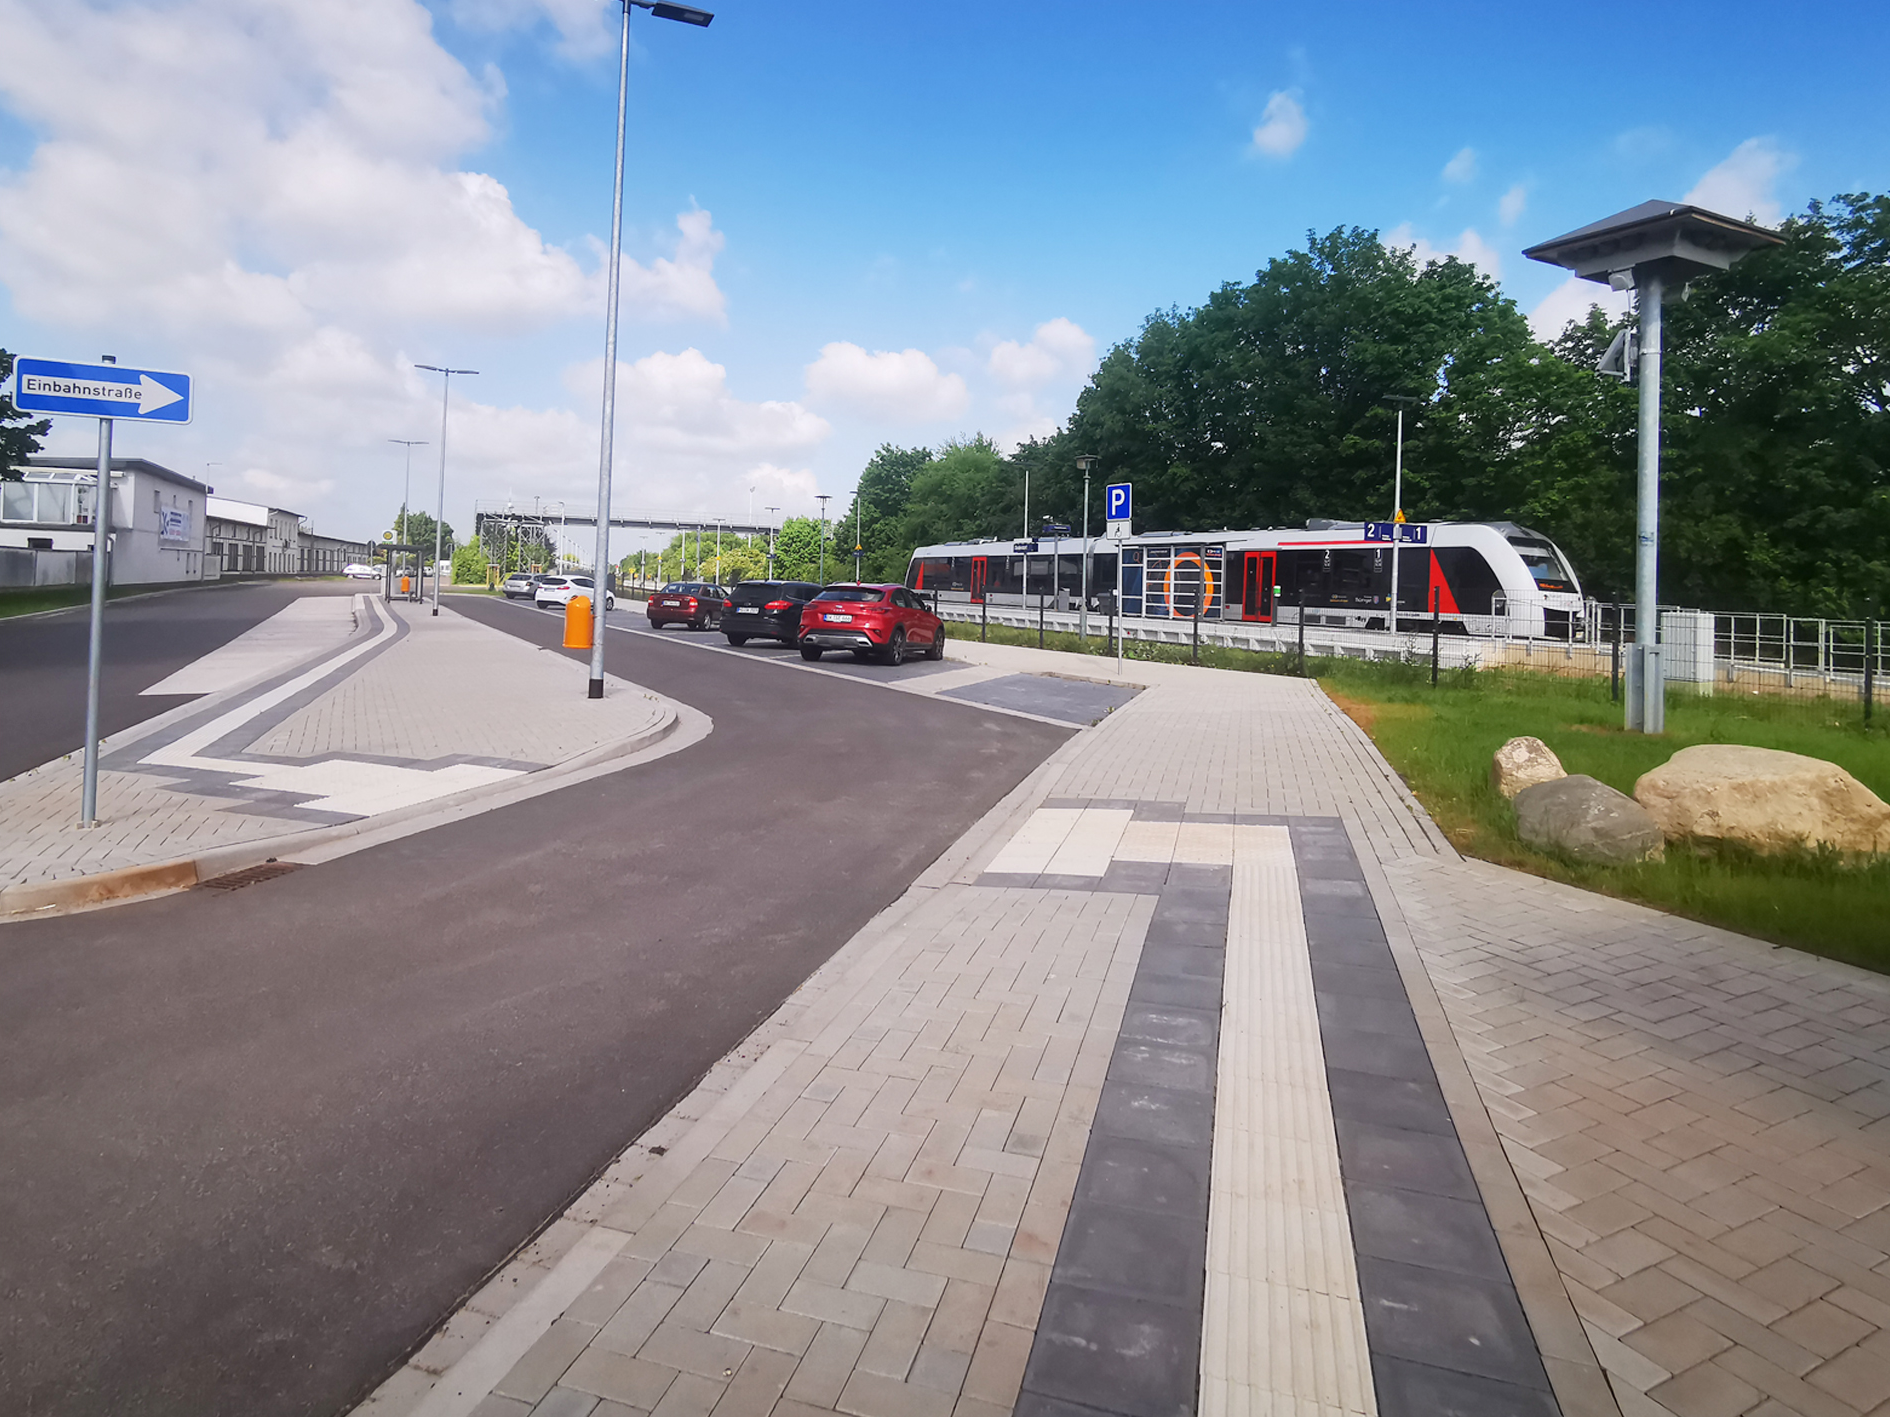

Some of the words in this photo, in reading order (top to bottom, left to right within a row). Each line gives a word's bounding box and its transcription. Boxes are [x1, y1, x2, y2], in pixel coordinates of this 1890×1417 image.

[27, 378, 142, 400] Einbahnstraße
[1112, 488, 1126, 516] P
[1367, 523, 1376, 538] 2
[1415, 526, 1422, 541] 1
[1324, 549, 1330, 560] 2
